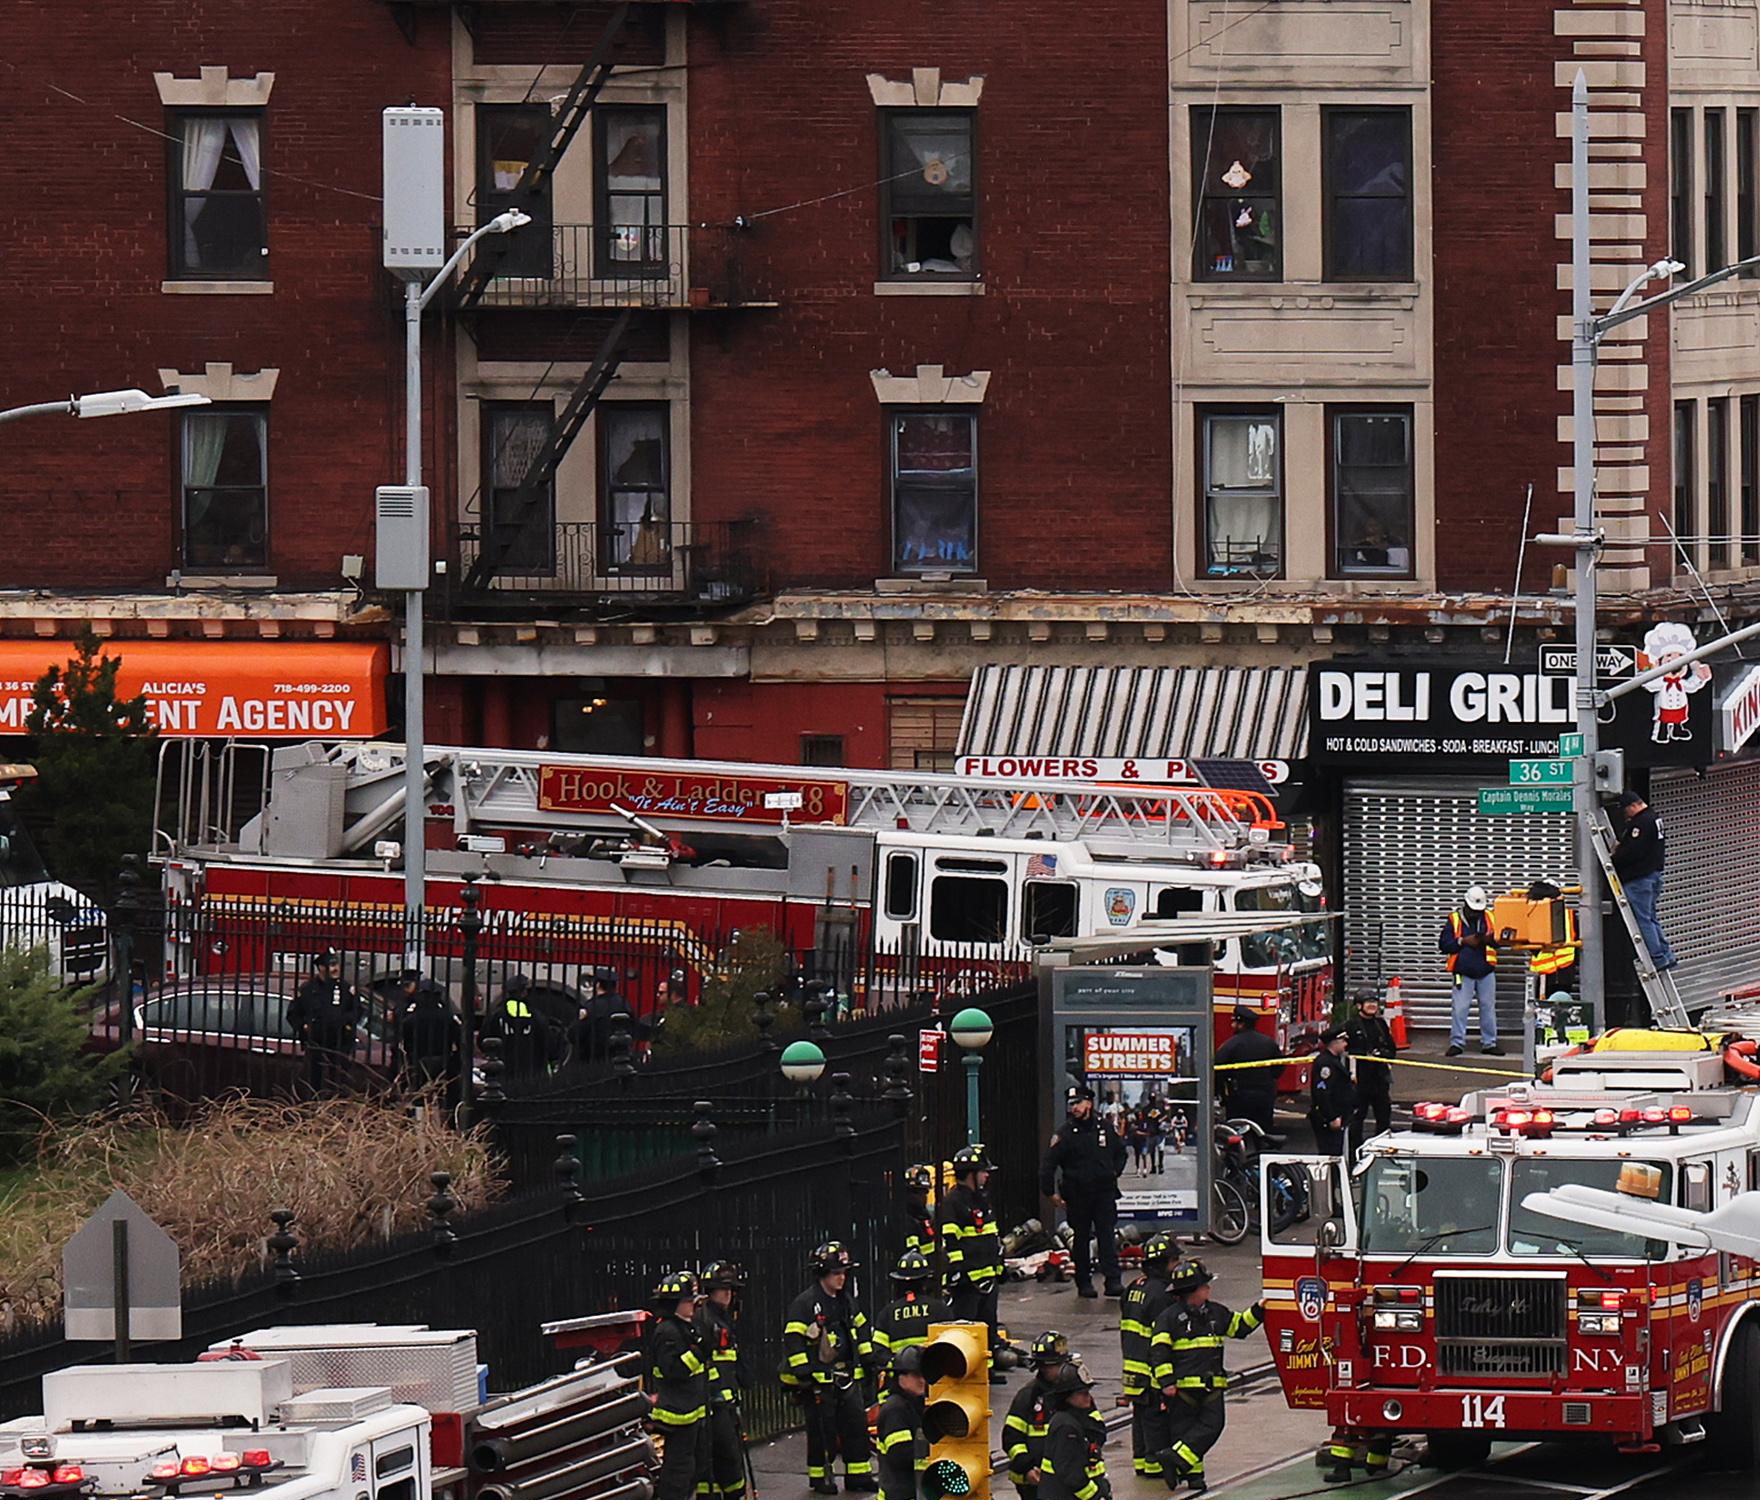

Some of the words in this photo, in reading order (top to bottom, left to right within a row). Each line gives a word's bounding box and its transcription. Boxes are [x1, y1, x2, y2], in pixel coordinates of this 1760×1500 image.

[1548, 654, 1577, 668] ONE
[1597, 655, 1624, 668] WAY
[141, 683, 207, 694] ALICIA'S
[273, 684, 350, 693] 718-499-2200
[1320, 672, 1430, 721] DELI
[217, 697, 355, 731] AGENCY
[1326, 737, 1345, 752] HOT
[1346, 738, 1352, 751] &
[1353, 738, 1378, 752] COLD
[1379, 738, 1436, 753] SANDWICHES
[1442, 739, 1467, 753] SODA
[1473, 739, 1524, 754] BREAKFAST
[1529, 740, 1559, 754] LUNCH
[965, 759, 1098, 776] FLOWERS
[1121, 760, 1139, 777] &
[1519, 763, 1542, 782] 36
[1549, 762, 1566, 776] ST
[559, 773, 631, 802] Hook
[642, 777, 664, 798] &
[674, 779, 765, 805] Ladder
[1482, 790, 1510, 805] Captain
[1513, 790, 1540, 803] Dennis
[1542, 789, 1572, 802] Morales
[1087, 1037, 1171, 1052] SUMMER
[1087, 1053, 1171, 1069] STREETS
[1286, 1354, 1318, 1369] JIMMY
[1373, 1345, 1433, 1369] F.D.
[1461, 1395, 1506, 1427] 114
